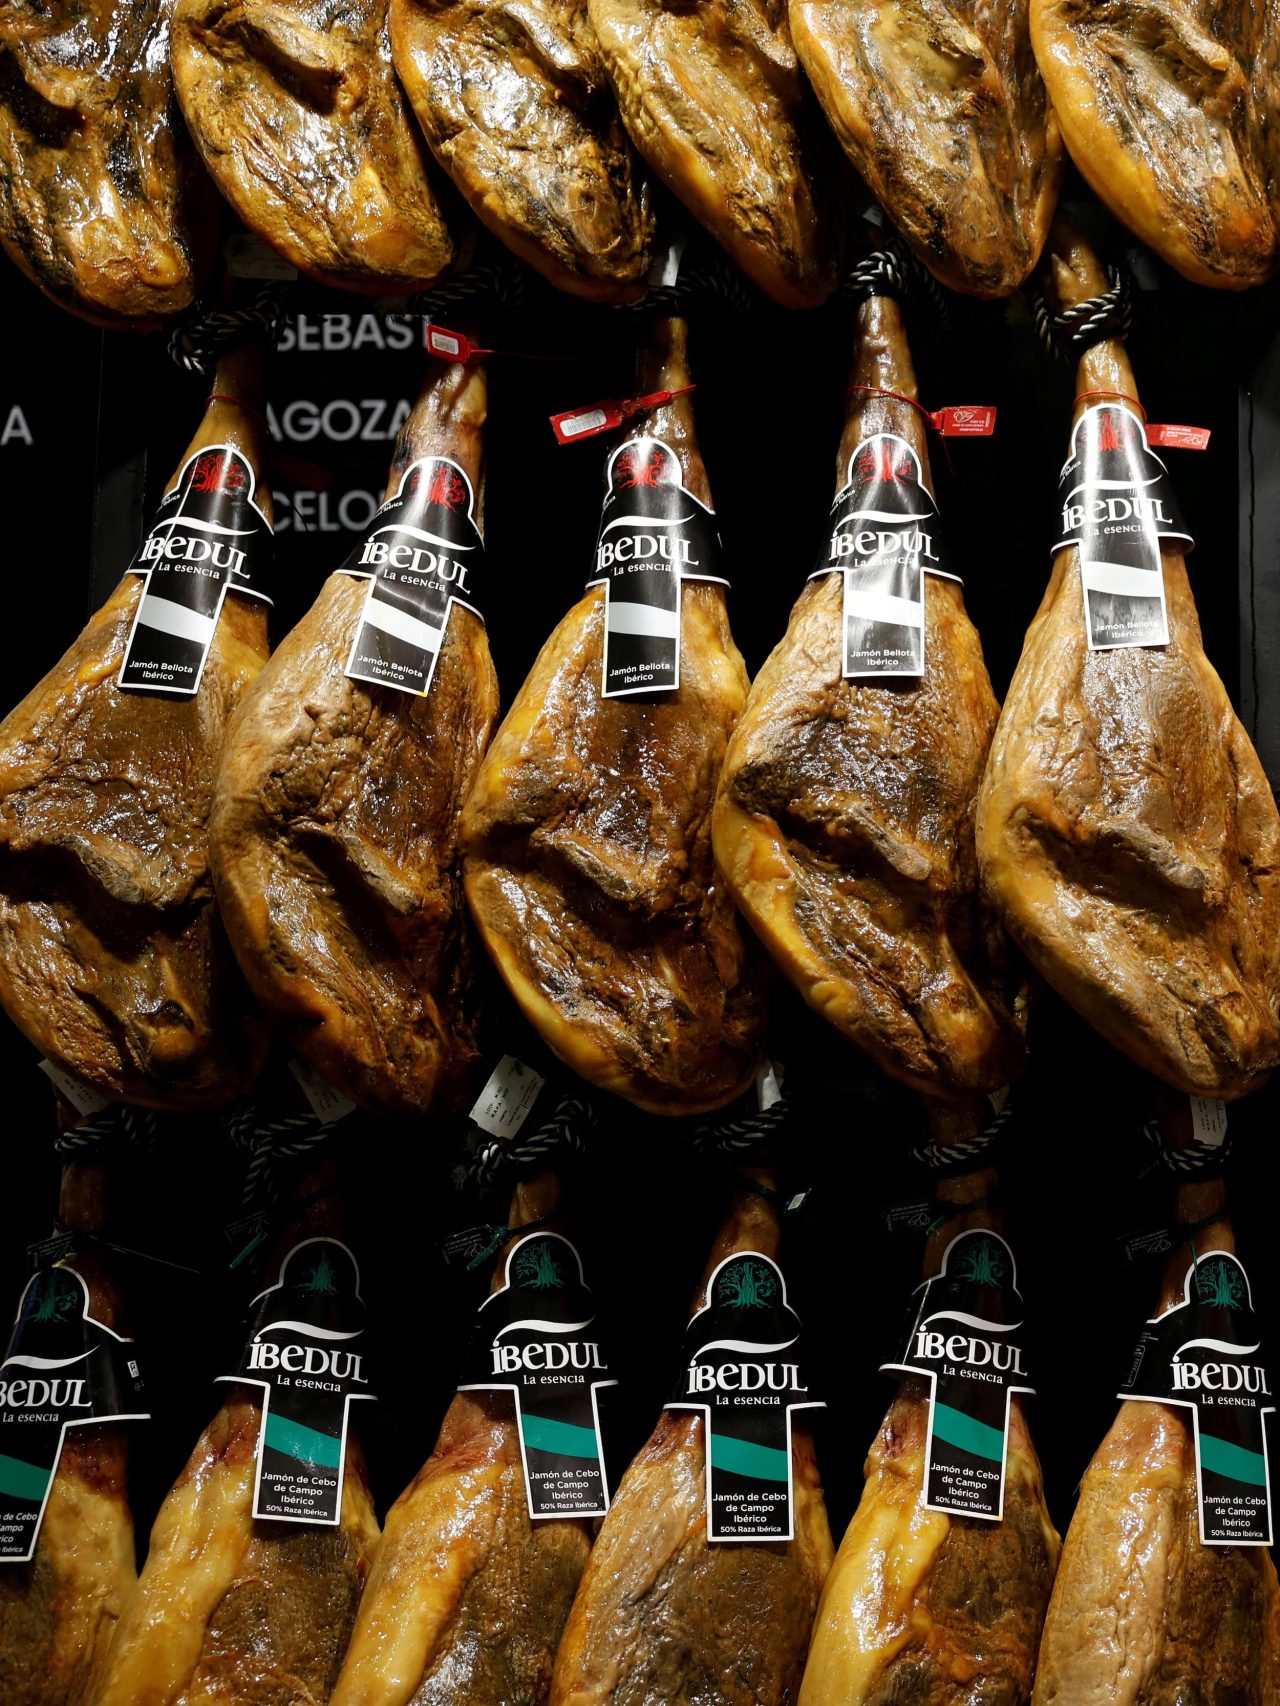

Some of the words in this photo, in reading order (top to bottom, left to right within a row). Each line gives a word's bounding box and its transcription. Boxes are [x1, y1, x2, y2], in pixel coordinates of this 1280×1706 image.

[851, 649, 880, 657] Jamón
[883, 649, 915, 657] Bellota
[129, 661, 158, 669] Jamón
[161, 663, 193, 673] Bellota
[358, 655, 388, 668] Jamón
[391, 663, 423, 677] Bellota
[867, 658, 899, 666] Ibérico
[372, 667, 404, 680] Ibérico
[610, 666, 636, 676] Jamón
[639, 662, 670, 671] Bellota
[143, 671, 173, 680] Ibérico
[624, 673, 653, 683] Ibérico
[943, 1364, 955, 1376] La
[277, 1375, 290, 1386] La
[523, 1375, 536, 1385] La
[716, 1395, 729, 1405] La
[1202, 1394, 1214, 1404] La
[530, 1471, 560, 1480] Jamón
[576, 1469, 600, 1477] Cebo
[931, 1463, 960, 1474] Jamón
[963, 1468, 974, 1476] de
[976, 1470, 1000, 1481] Cebo
[262, 1472, 294, 1483] Jamón
[297, 1476, 308, 1484] de
[312, 1477, 336, 1486] Cebo
[942, 1475, 953, 1483] de
[955, 1478, 987, 1490] Campo
[274, 1484, 286, 1492] de
[289, 1486, 323, 1496] Campo
[543, 1481, 554, 1489] de
[557, 1480, 589, 1490] Campo
[552, 1491, 583, 1499] Ibérico
[713, 1492, 744, 1501] Jamón
[747, 1493, 759, 1501] de
[762, 1493, 787, 1501] Cebo
[948, 1487, 979, 1499] Ibérico
[281, 1495, 314, 1505] Ibérico
[1204, 1496, 1230, 1504] Jamón
[1245, 1497, 1266, 1506] Cebo
[726, 1504, 738, 1512] de
[741, 1504, 774, 1513] Campo
[1215, 1507, 1225, 1515] de
[1228, 1508, 1256, 1516] Campo
[734, 1514, 767, 1523] Ibérico
[1222, 1518, 1250, 1527] Ibérico
